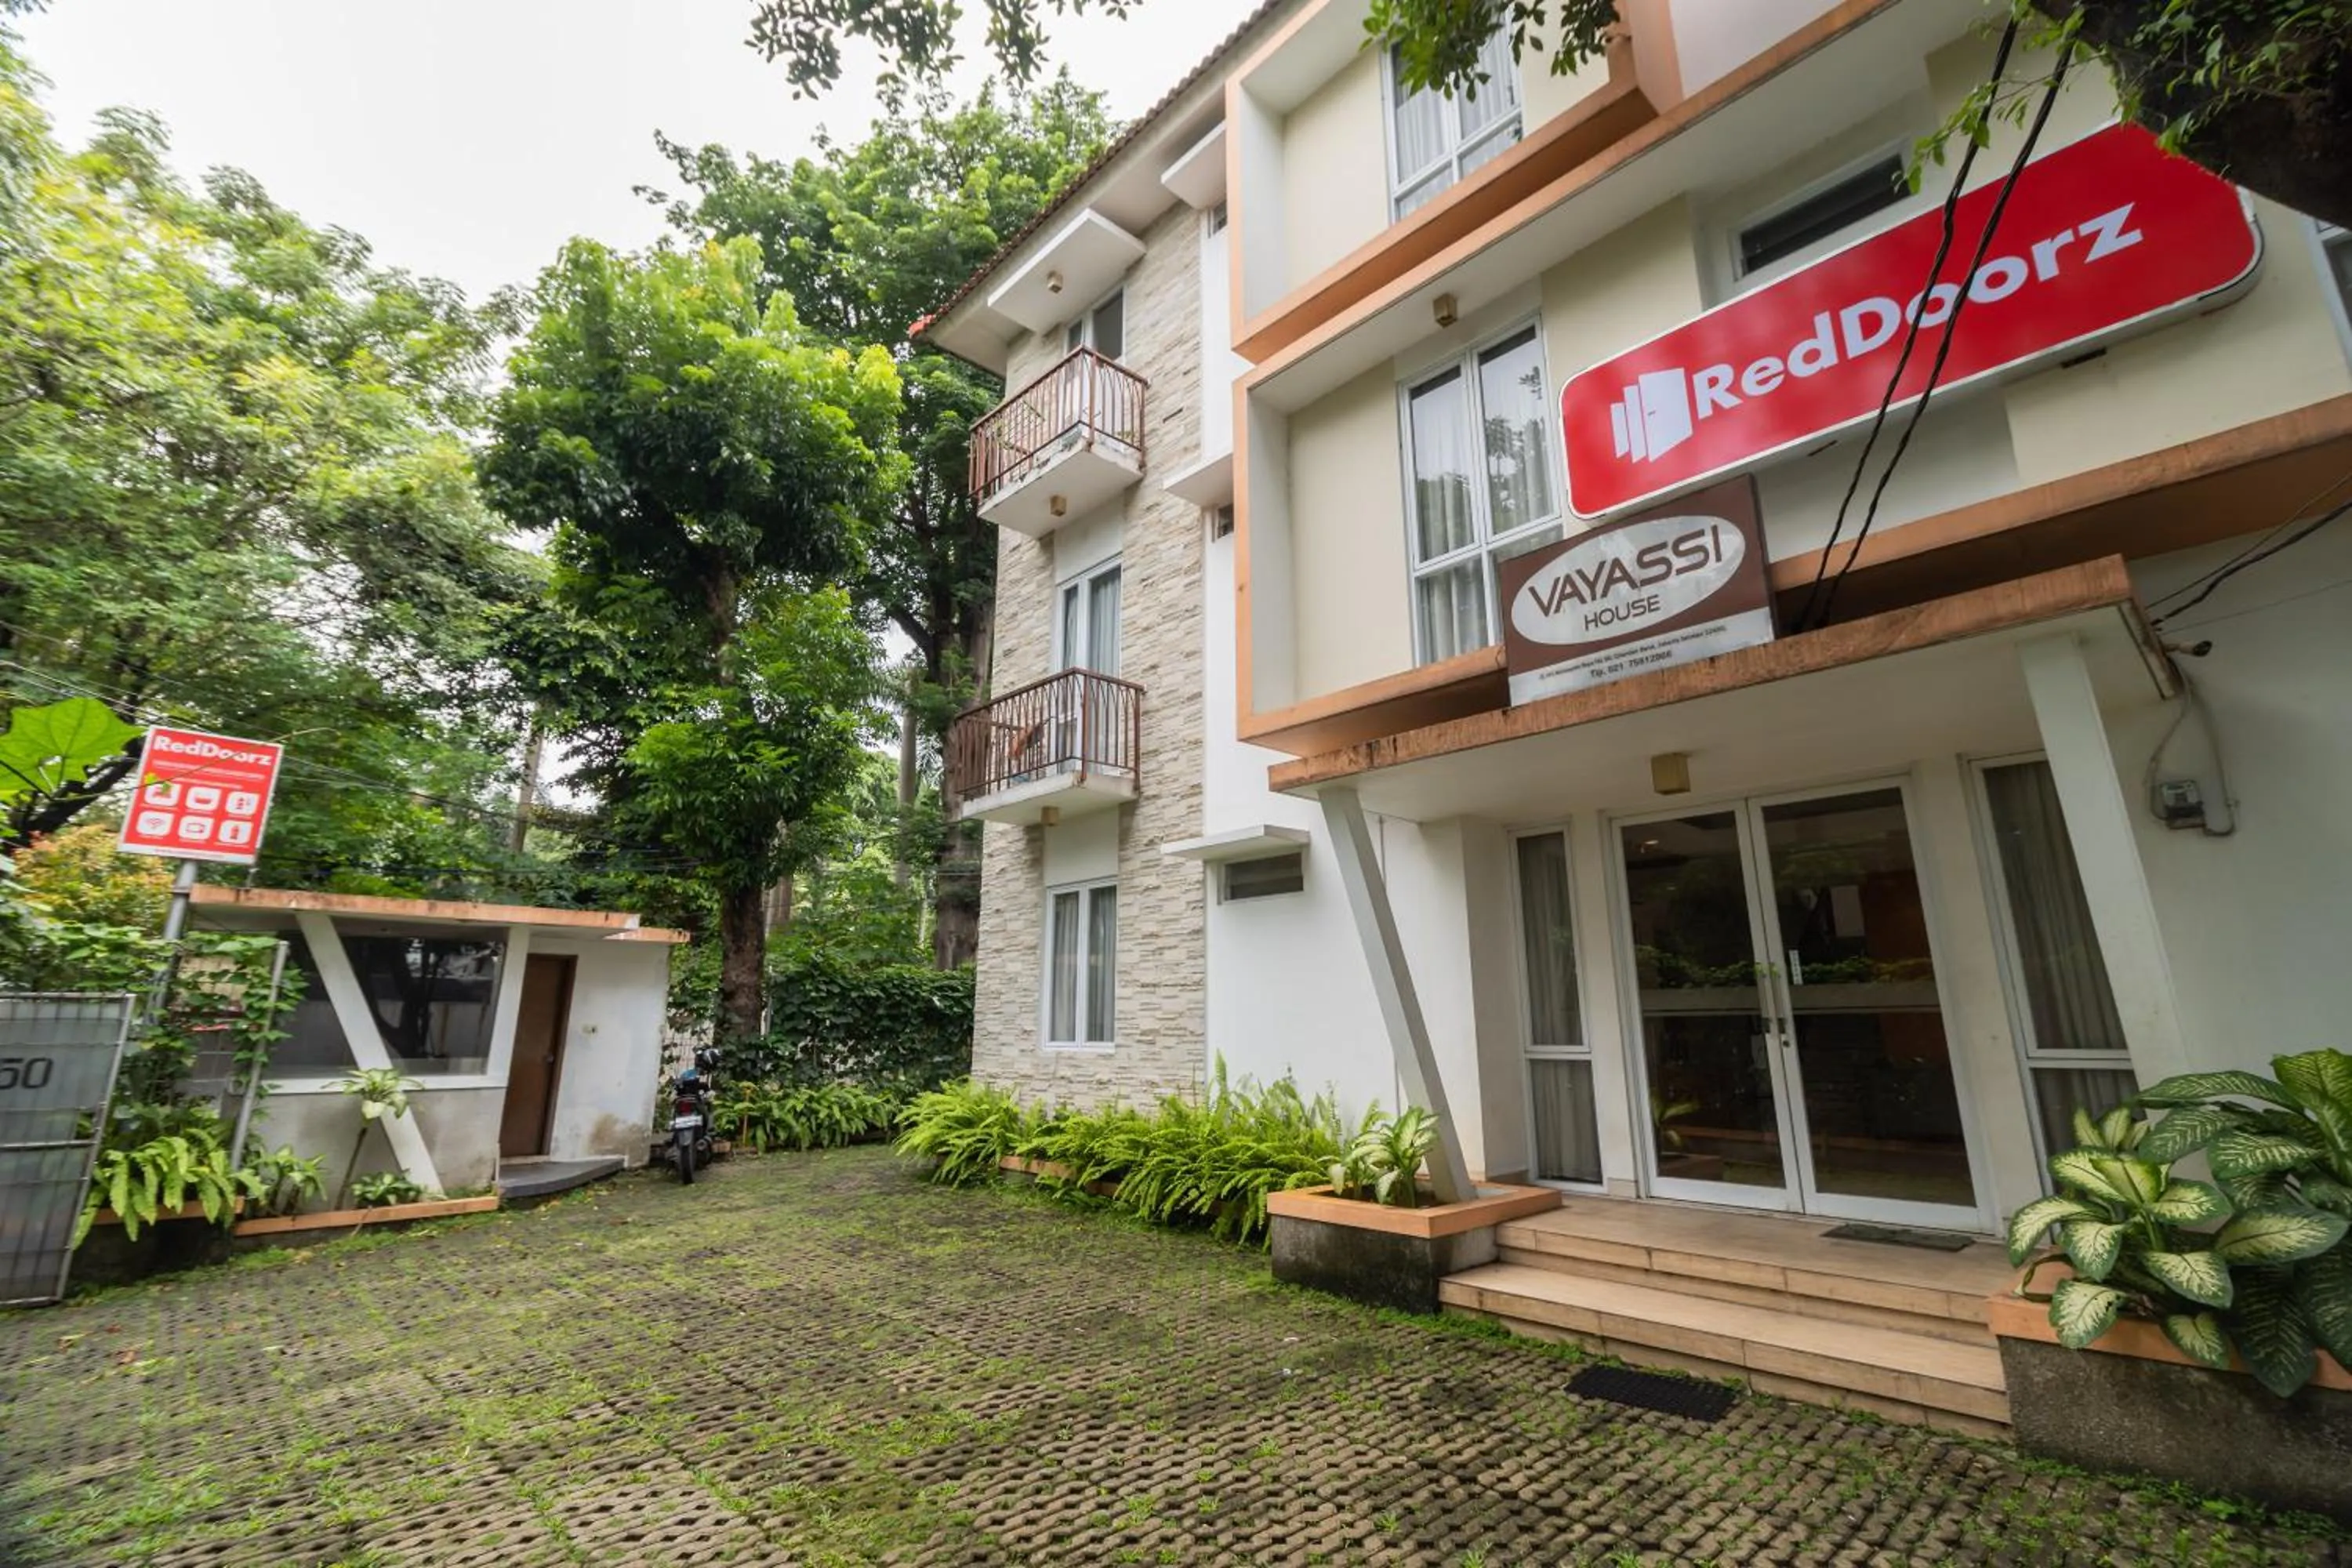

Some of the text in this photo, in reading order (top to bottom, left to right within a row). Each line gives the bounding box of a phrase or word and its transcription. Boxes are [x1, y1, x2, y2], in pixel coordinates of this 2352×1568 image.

[1693, 202, 2143, 420] RedDoorz
[1529, 524, 1722, 618] VAYASSI
[1584, 594, 1661, 631] HOUSE
[153, 735, 271, 766] RedDoorz
[0, 1057, 53, 1091] 50
